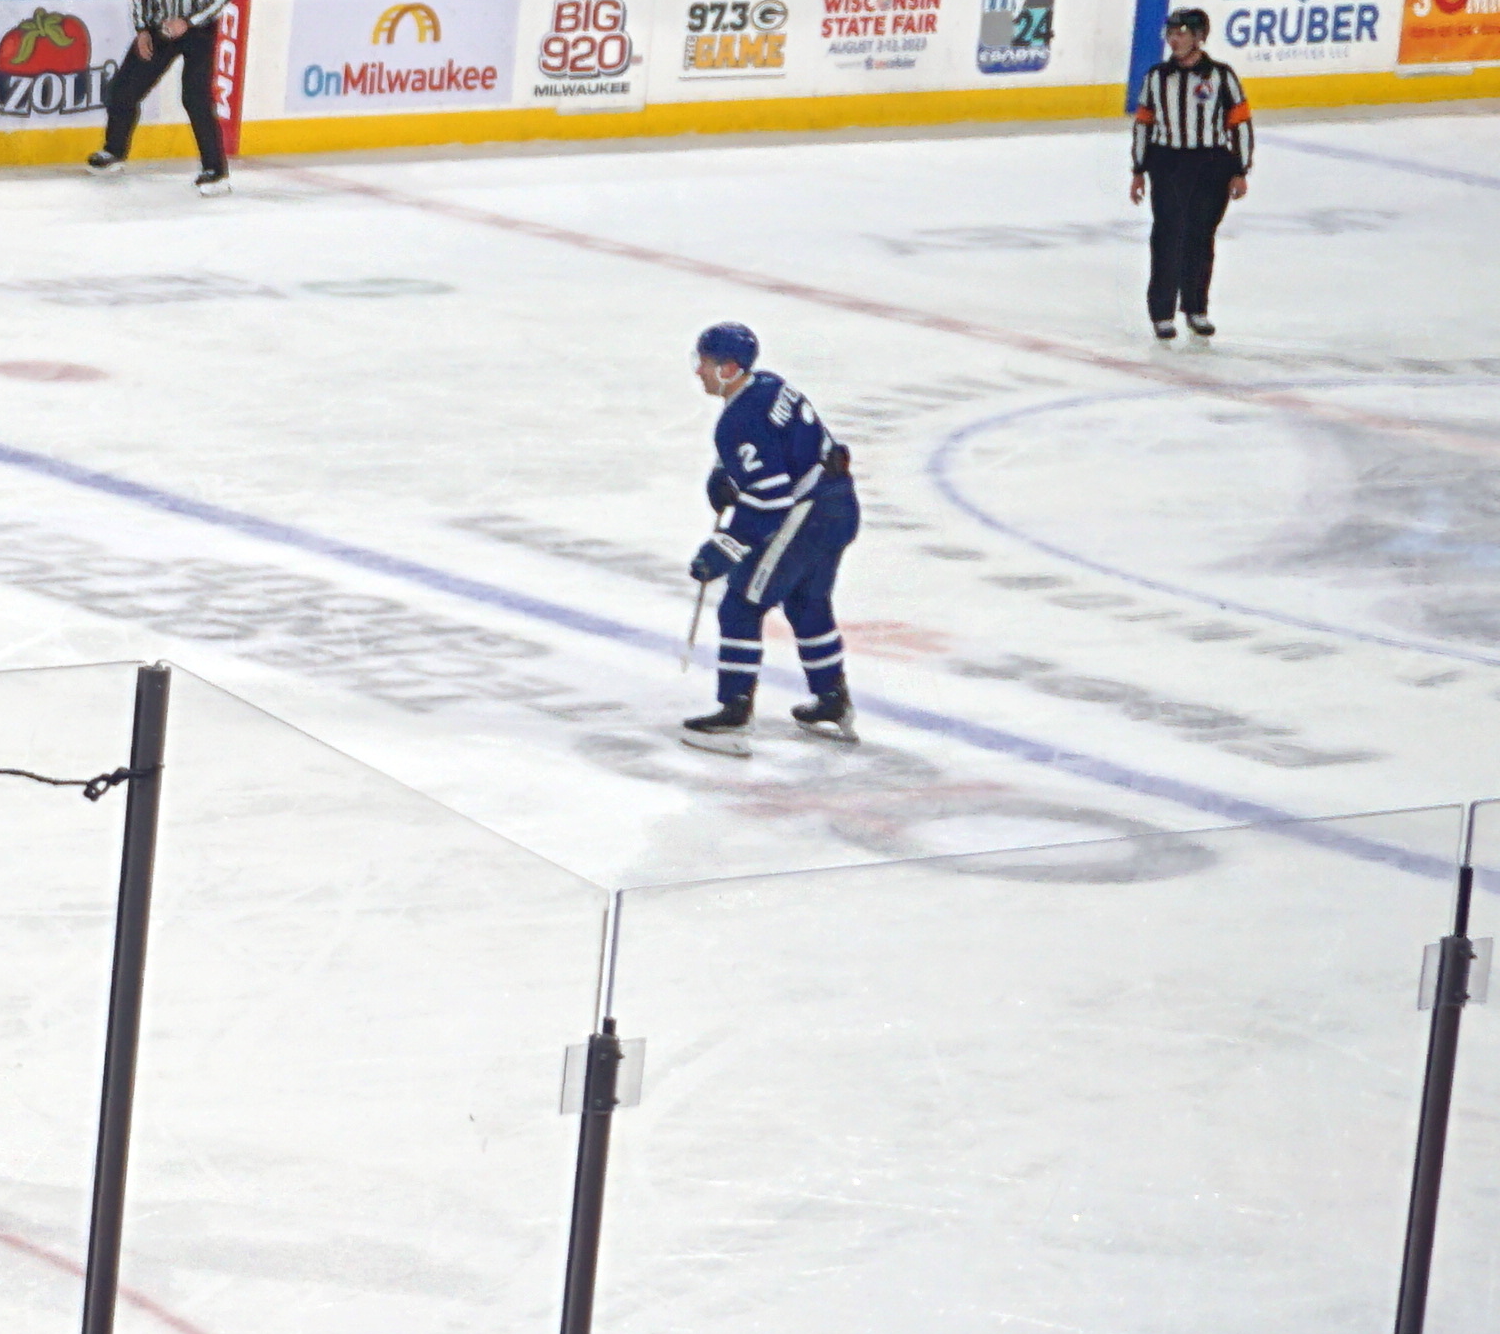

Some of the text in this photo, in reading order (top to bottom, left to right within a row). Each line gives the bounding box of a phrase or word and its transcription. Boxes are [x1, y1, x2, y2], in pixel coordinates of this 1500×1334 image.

[686, 0, 751, 33] 97.3
[820, 10, 939, 38] STATE FAIR
[1012, 9, 1054, 46] 24
[1225, 3, 1380, 49] GRUBER
[213, 1, 240, 121] CCM
[540, 34, 630, 75] 920
[694, 33, 787, 70] GAME
[303, 59, 498, 98] OnMilwaukee
[533, 81, 631, 98] MILWAUKEE
[737, 443, 764, 472] 2
